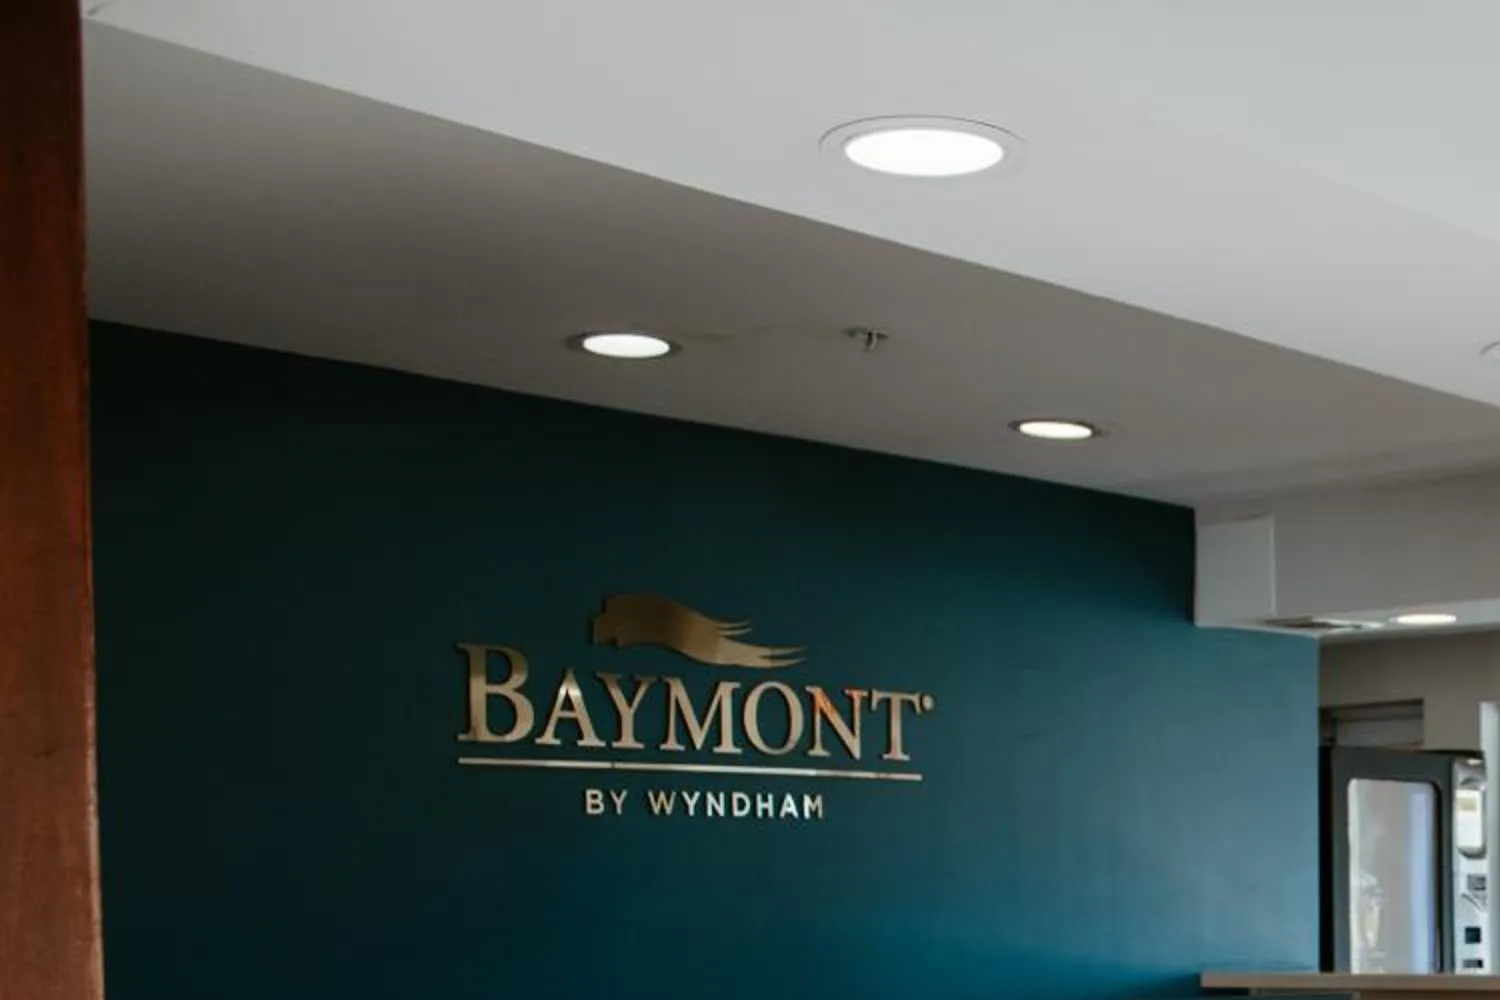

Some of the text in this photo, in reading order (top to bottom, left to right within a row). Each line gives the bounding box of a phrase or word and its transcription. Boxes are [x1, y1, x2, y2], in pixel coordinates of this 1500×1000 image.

[456, 643, 923, 761] BAYMONT
[585, 789, 824, 820] BY WYNDHAM
